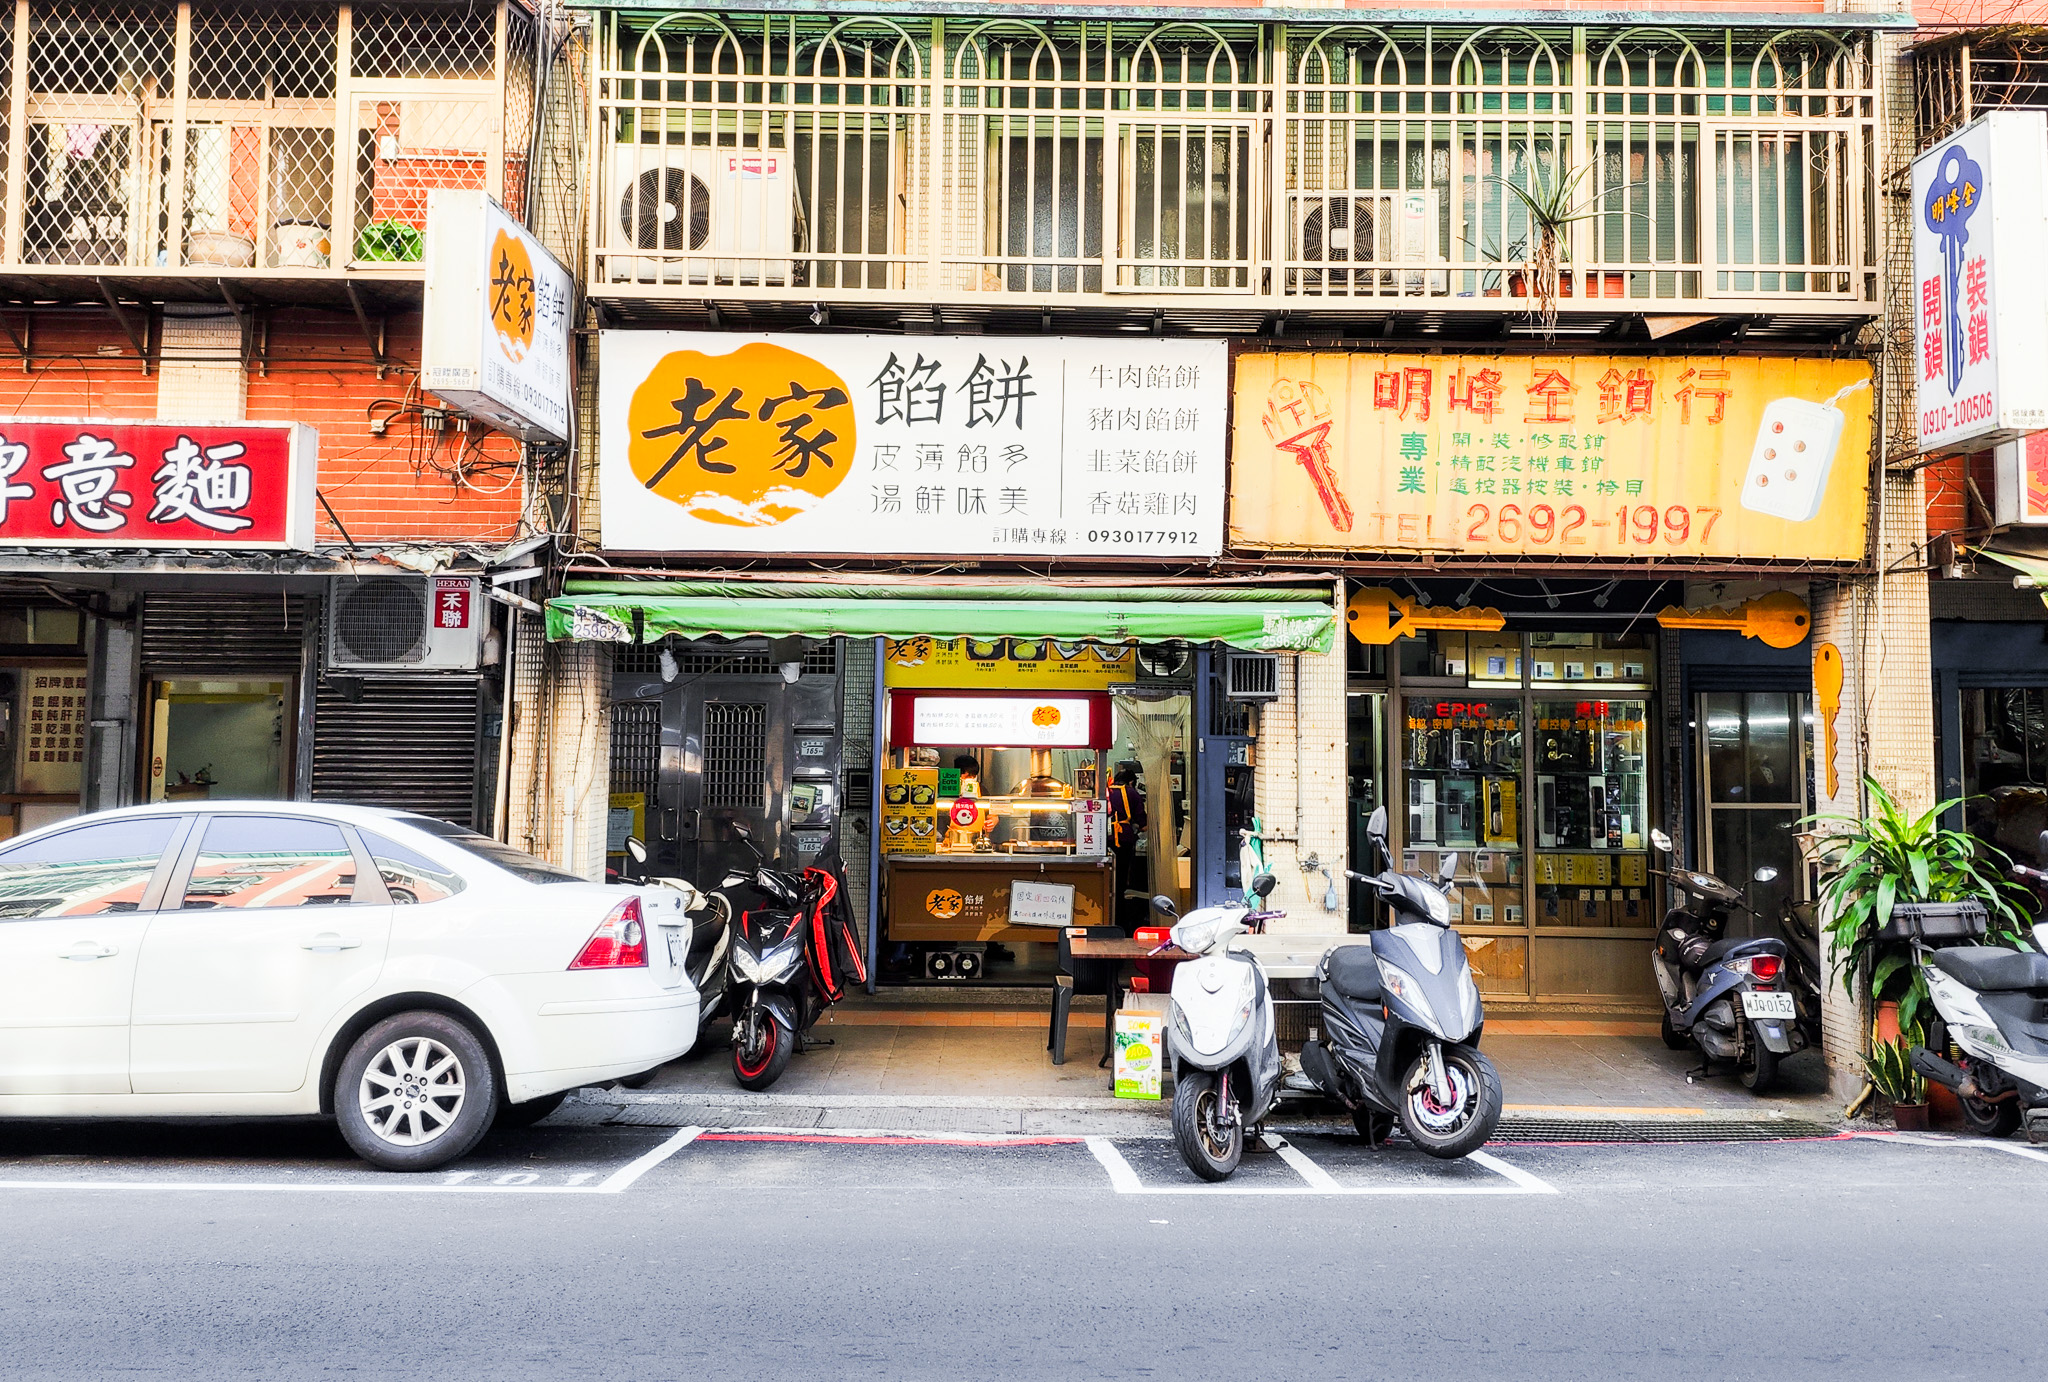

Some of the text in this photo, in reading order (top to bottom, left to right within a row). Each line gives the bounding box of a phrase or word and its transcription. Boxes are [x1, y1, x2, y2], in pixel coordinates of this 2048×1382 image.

[492, 248, 535, 335] 老家
[537, 272, 565, 333] 餡餅
[1966, 254, 1990, 366] 裝鎖
[1922, 275, 1944, 382] 開鎖
[866, 351, 1037, 431] 餡餅
[1088, 364, 1201, 390] 牛肉餡餅
[523, 383, 565, 425] 0930177912
[1087, 406, 1200, 432] 豬肉餡餅
[1922, 391, 1993, 437] 0910-100506
[642, 377, 849, 491] 老家
[872, 443, 1028, 473] 皮薄餡多
[1086, 449, 1198, 475] 韭菜餡餅
[1399, 431, 1428, 495] 專業
[871, 484, 1028, 516] 湯鮮味美
[1086, 491, 1197, 516] 香菇雞肉
[1088, 530, 1198, 544] 0930177912
[1466, 503, 1723, 545] 2692-1997
[442, 592, 462, 628] 禾聯
[888, 637, 930, 660] 老家
[1262, 635, 1321, 649] 2596-2406
[34, 676, 87, 689] 招牌意麵
[1436, 702, 1488, 718] EPIC
[1083, 814, 1094, 850] 買十送一
[928, 893, 985, 912] 老家 餡餅
